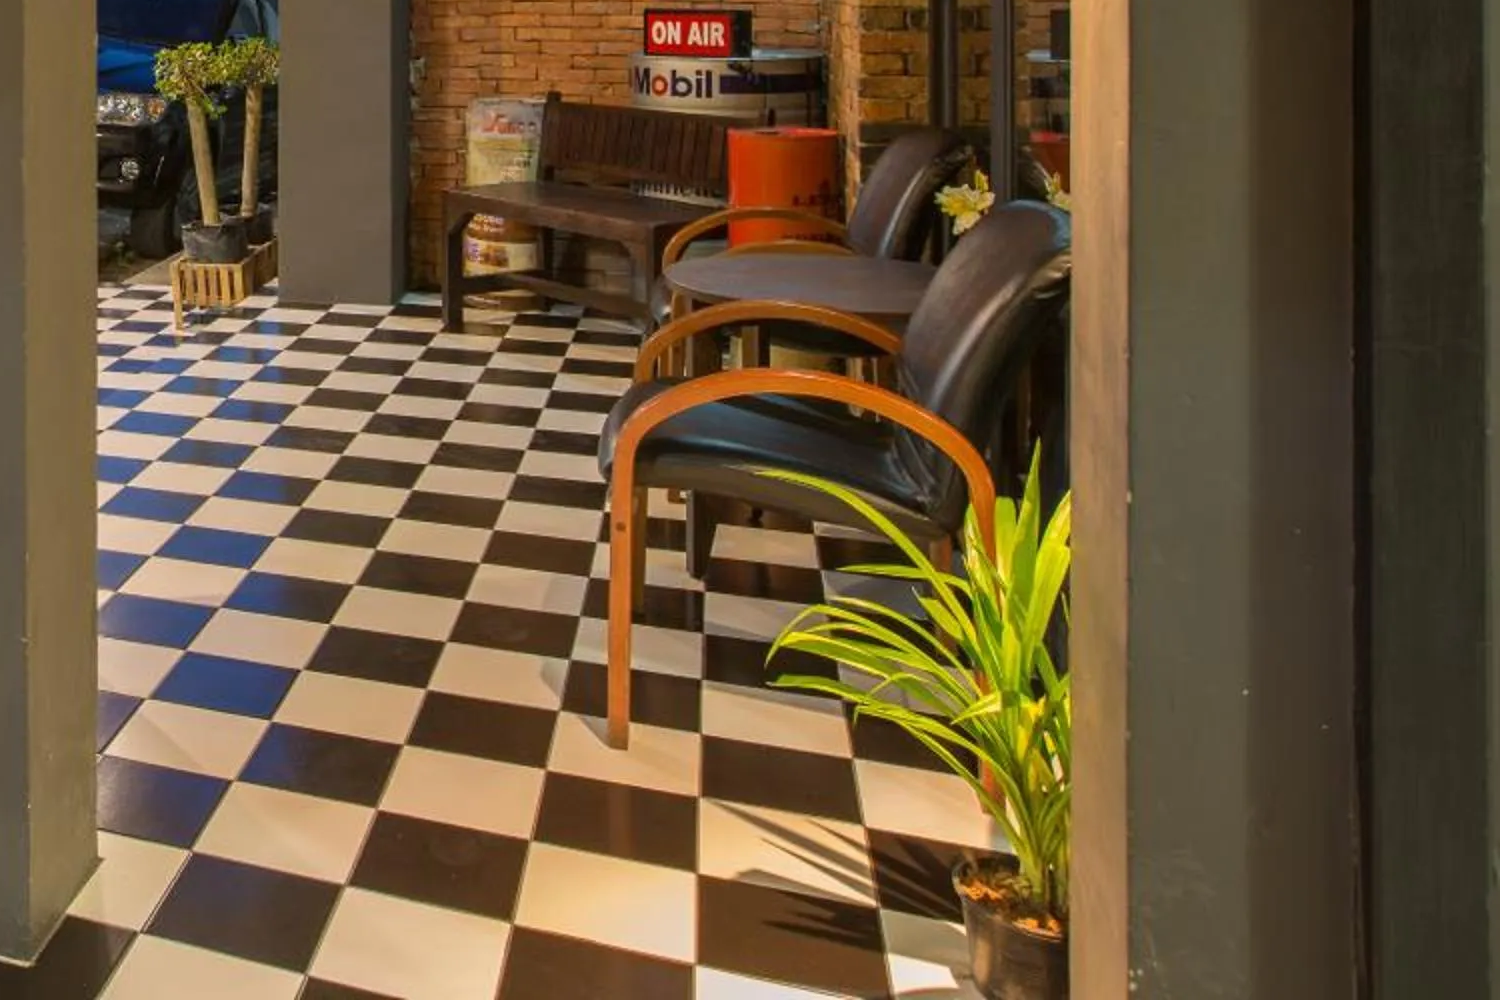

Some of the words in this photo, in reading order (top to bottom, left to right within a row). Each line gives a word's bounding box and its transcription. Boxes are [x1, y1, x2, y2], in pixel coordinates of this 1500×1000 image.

[651, 21, 683, 46] ON
[686, 22, 725, 47] AIR
[633, 66, 713, 99] Mobil
